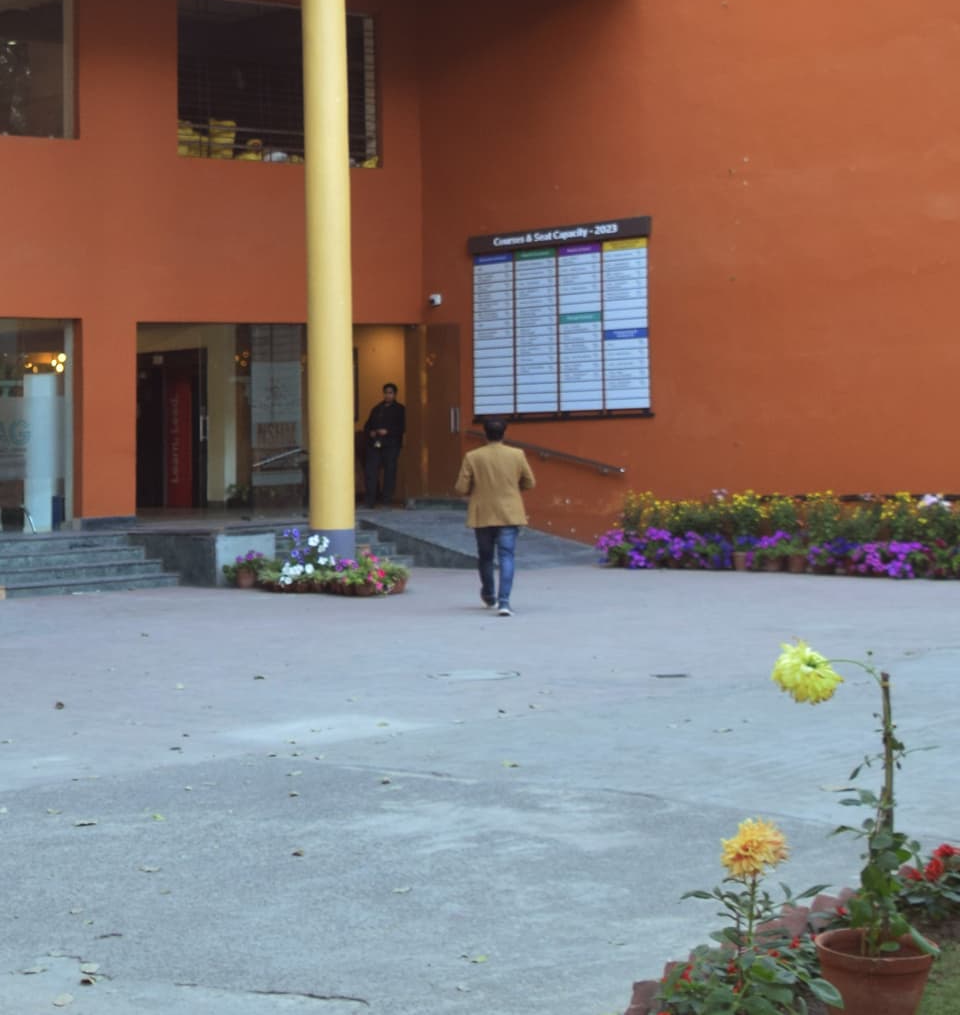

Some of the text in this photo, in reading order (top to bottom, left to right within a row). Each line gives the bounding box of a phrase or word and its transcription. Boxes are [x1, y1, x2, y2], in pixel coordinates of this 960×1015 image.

[493, 236, 524, 247] Courses
[526, 233, 533, 244] &
[534, 231, 552, 242] Seat
[553, 227, 588, 241] Capacity
[594, 223, 618, 235] 2023
